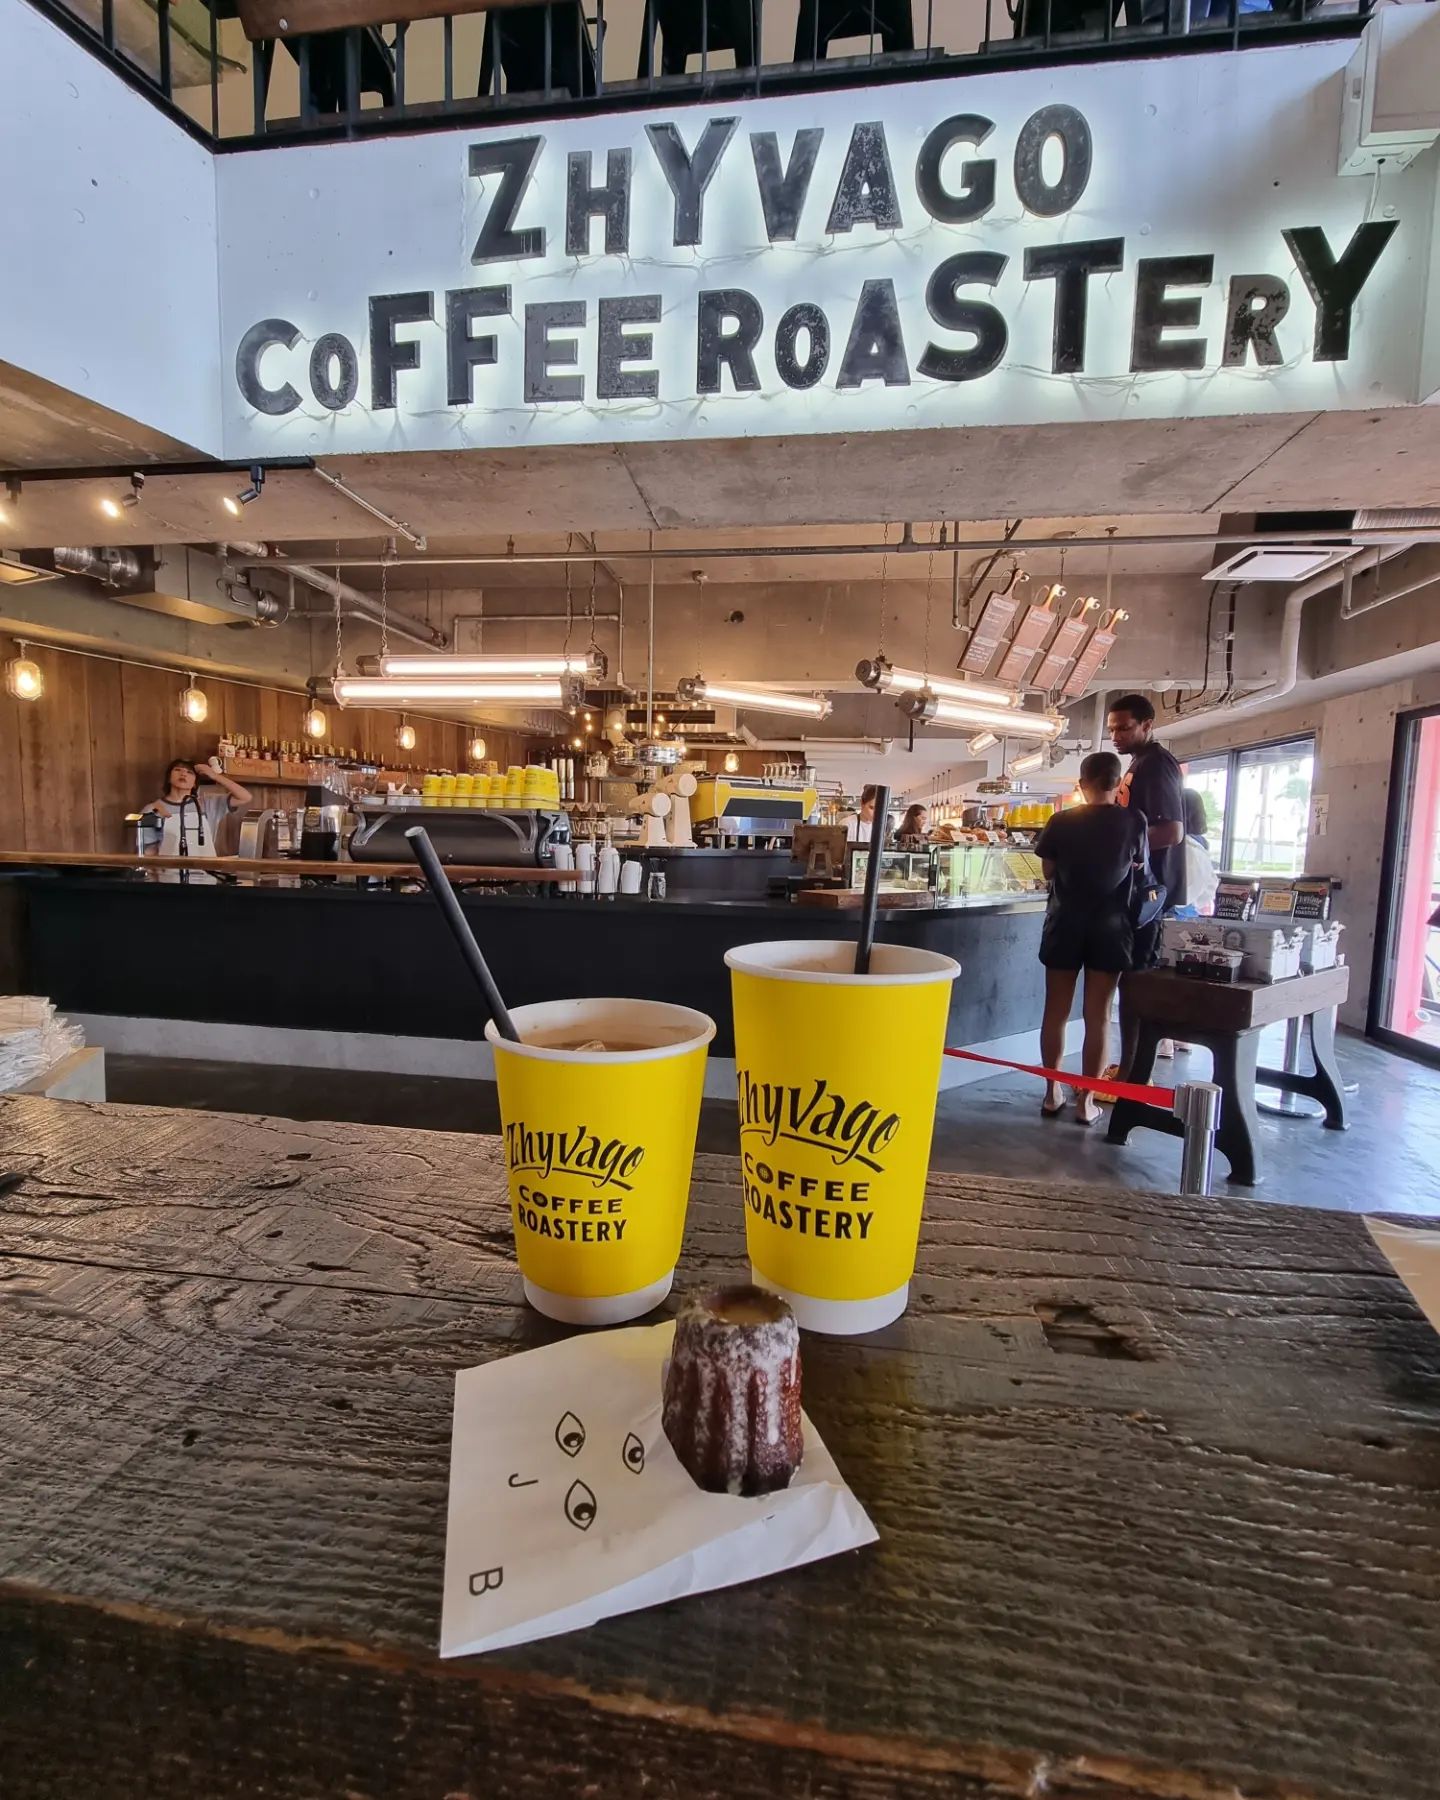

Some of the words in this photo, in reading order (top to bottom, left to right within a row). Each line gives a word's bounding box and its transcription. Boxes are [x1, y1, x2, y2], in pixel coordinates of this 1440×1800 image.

[468, 103, 1093, 266] ZHYVAGO
[236, 283, 662, 416] COFFEE
[696, 220, 1400, 394] ROASTERY
[507, 1122, 645, 1189] Zhyvago
[744, 1152, 870, 1202] COFFEE
[518, 1203, 627, 1243] ROASTERY
[519, 1184, 623, 1214] COFFEE
[469, 1566, 504, 1597] B
